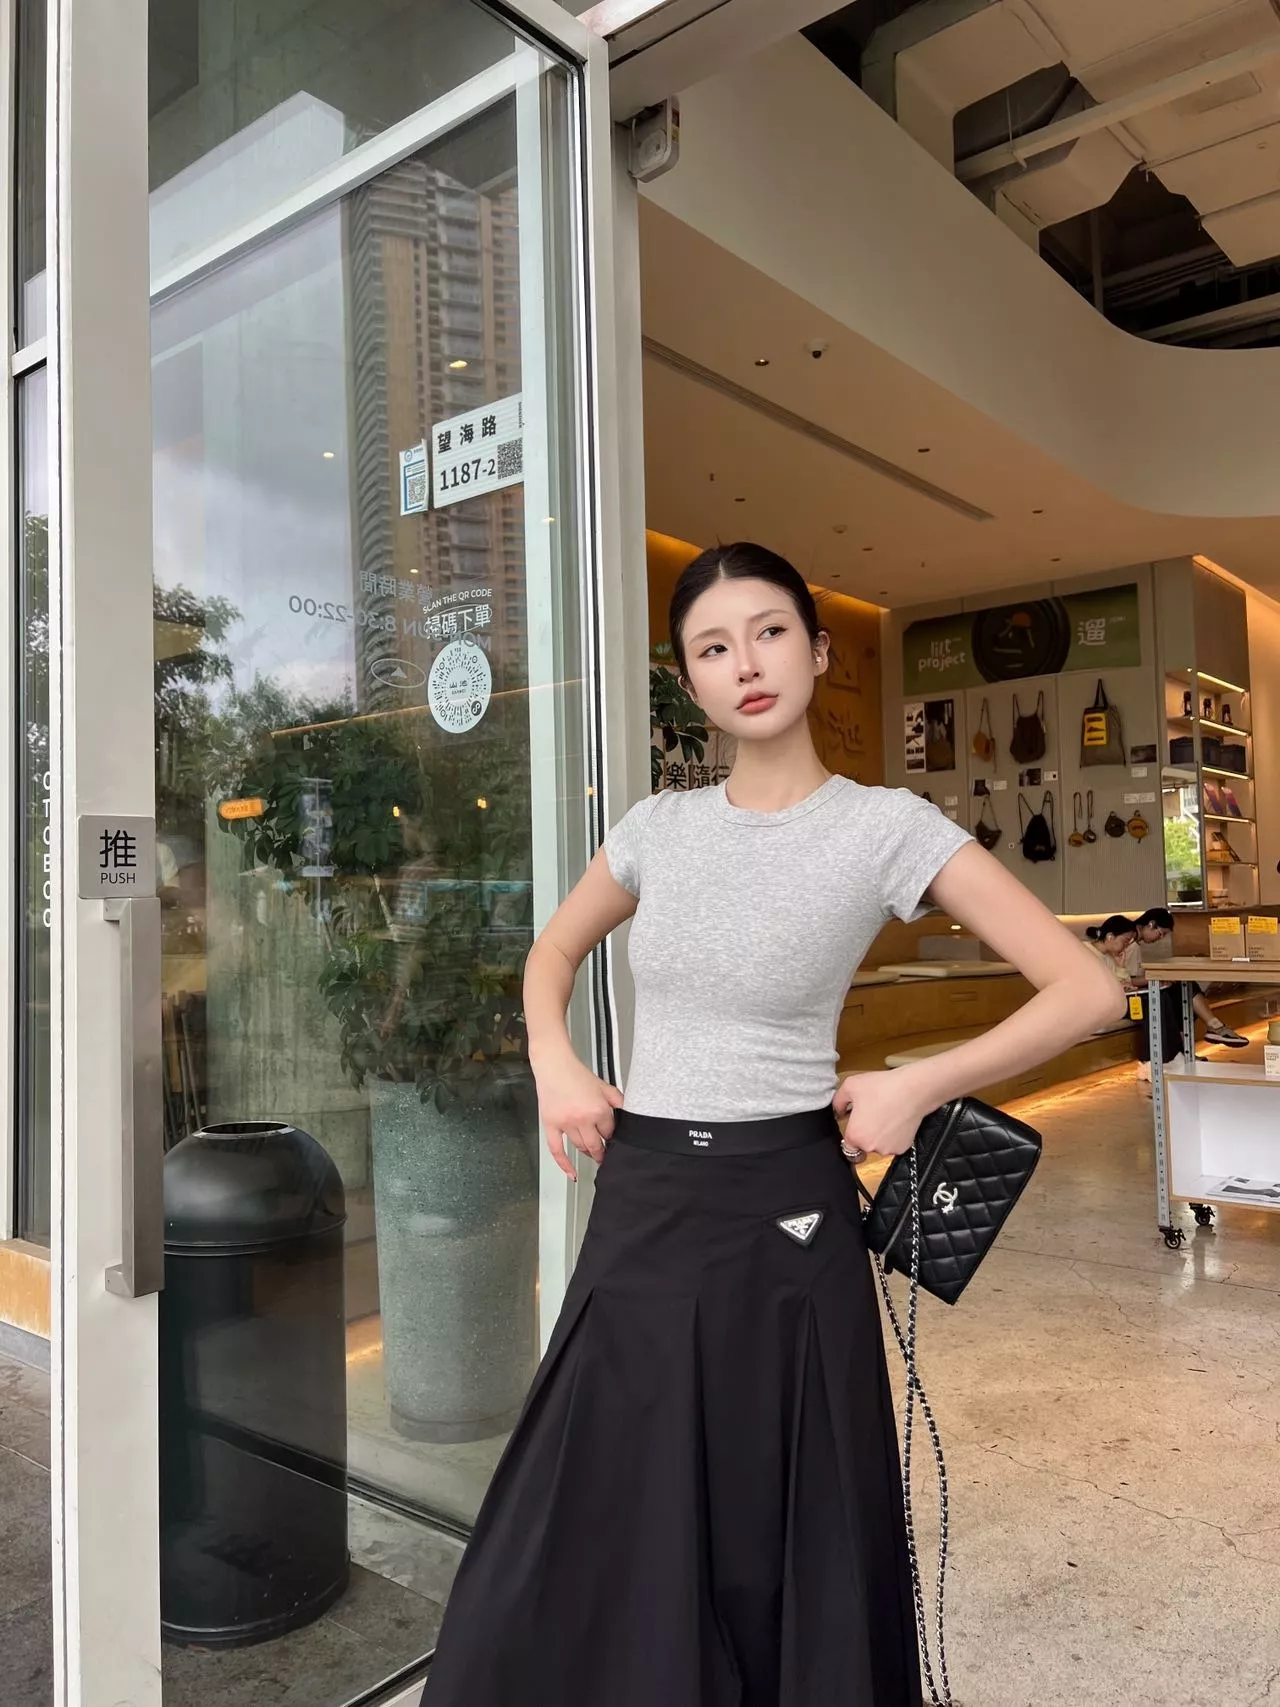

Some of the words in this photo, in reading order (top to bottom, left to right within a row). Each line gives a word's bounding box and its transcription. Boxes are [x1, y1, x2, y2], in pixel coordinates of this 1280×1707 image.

[437, 415, 497, 454] 望海路
[440, 458, 496, 491] 1187-2
[443, 594, 457, 604] THE
[458, 591, 470, 600] QR
[471, 588, 492, 598] CODE
[918, 652, 966, 672] project
[100, 829, 137, 868] 推
[100, 873, 136, 884] PUSH
[688, 1130, 713, 1139] PRADA
